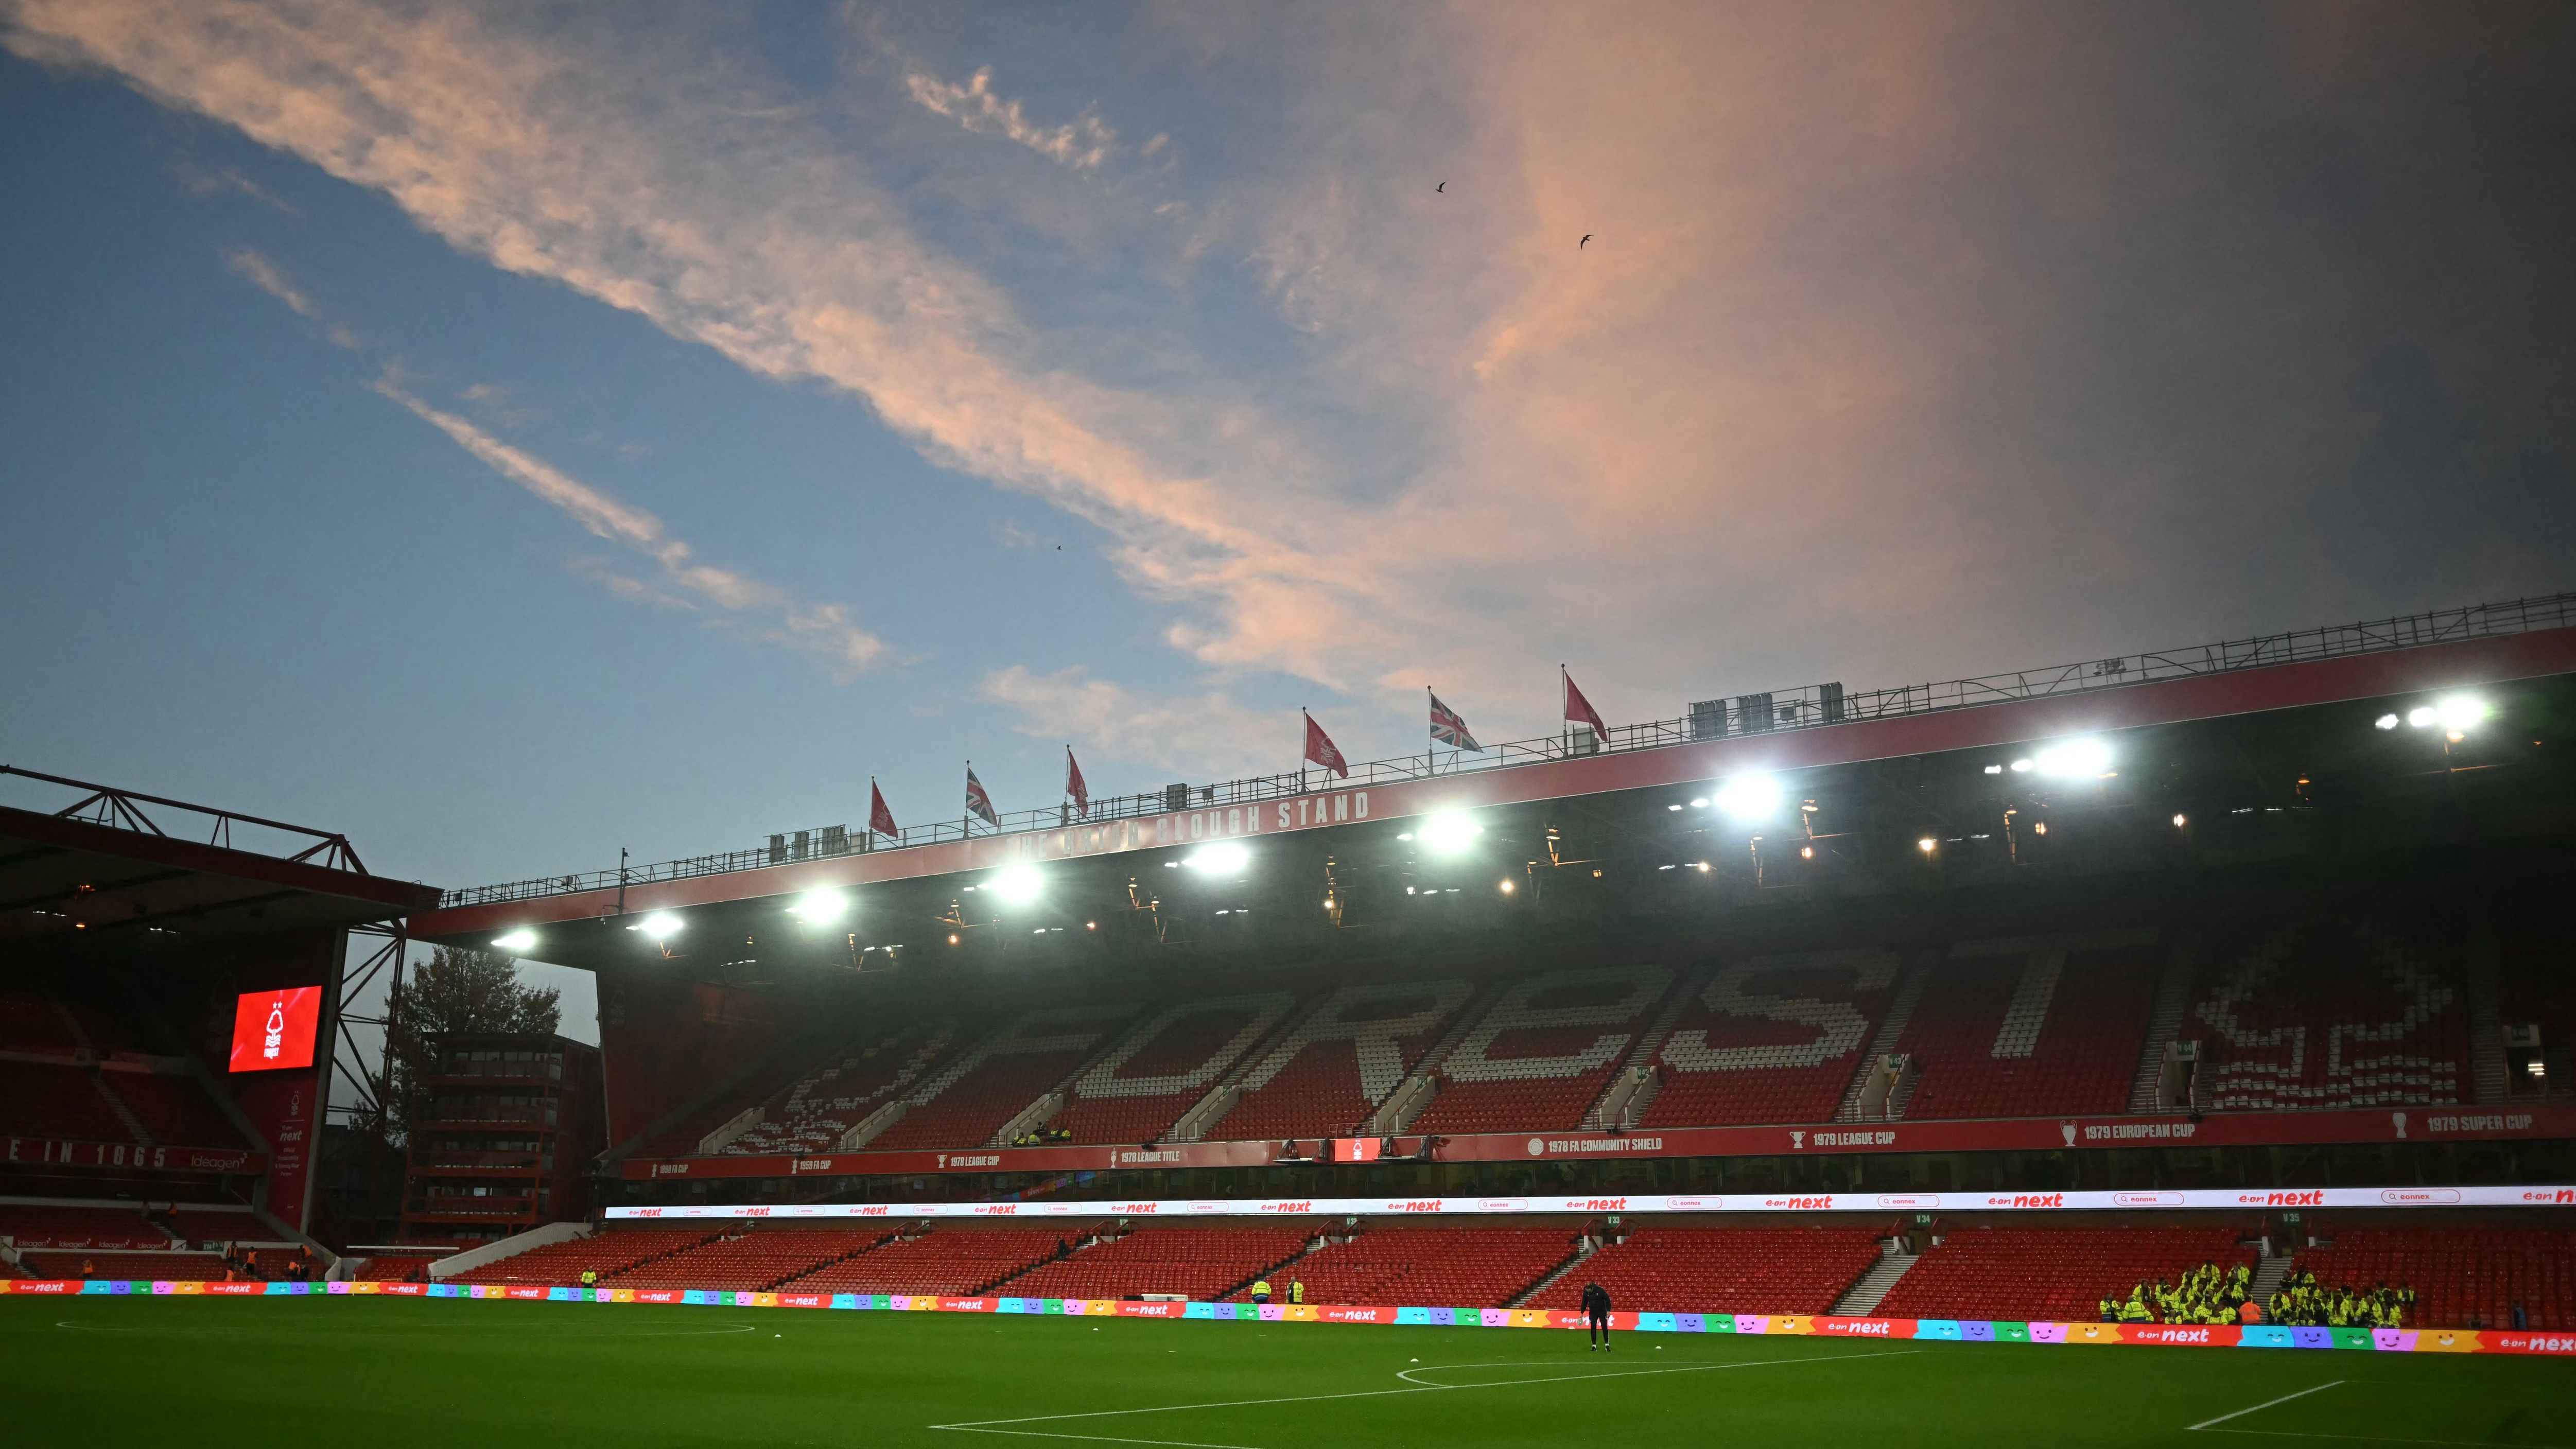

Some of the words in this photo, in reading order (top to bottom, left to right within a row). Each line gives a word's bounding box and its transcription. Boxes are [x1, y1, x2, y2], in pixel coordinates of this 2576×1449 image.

[1064, 822, 1139, 855] BRIAN
[1156, 806, 1259, 842] CLOUGH
[1278, 792, 1368, 828] STAND
[2428, 1117, 2458, 1131] 1979
[2461, 1115, 2504, 1130] SUPER
[2506, 1115, 2532, 1129] CUP
[280, 1130, 302, 1141] next
[2084, 1126, 2111, 1139] 1979
[2112, 1124, 2170, 1139] EUROPEAN
[2172, 1124, 2195, 1138] CUP
[1814, 1133, 1836, 1145] 1979
[1838, 1132, 1874, 1145] LEAGUE
[1876, 1131, 1895, 1144] CUP
[1548, 1141, 1568, 1153] 1978
[1570, 1140, 1579, 1152] FA
[1581, 1139, 1630, 1152] COMMUNITY
[1632, 1138, 1662, 1150] SHIELD
[9, 1139, 21, 1160] E
[44, 1141, 73, 1162] IN
[97, 1144, 165, 1166] 1865
[1121, 1152, 1136, 1162] 1978
[1137, 1151, 1161, 1162] LEAGUE
[1162, 1150, 1179, 1161] TITLE
[191, 1154, 239, 1171] Ideagen
[800, 1161, 812, 1169] 1959
[813, 1161, 820, 1169] FA
[821, 1160, 831, 1169] CUP
[951, 1157, 964, 1166] 1978
[965, 1156, 986, 1166] LEAGUE
[988, 1156, 999, 1165] CUP
[672, 1165, 678, 1173] FA
[678, 1164, 688, 1173] CUP
[1587, 1197, 1627, 1210] next
[1788, 1195, 1833, 1209] next
[2013, 1193, 2063, 1208] next
[2267, 1190, 2323, 1206] next
[862, 1205, 888, 1215] next
[988, 1203, 1016, 1214] next
[1126, 1202, 1156, 1213] next
[1278, 1201, 1311, 1212] next
[1406, 1199, 1442, 1211] next
[639, 1208, 662, 1217] next
[746, 1206, 770, 1216] next
[2289, 1214, 2300, 1222] 35
[18, 1239, 46, 1248] Ideagen
[99, 1240, 125, 1249] Ideagen
[137, 1242, 163, 1250] Ideagen
[34, 1282, 64, 1291] next
[225, 1284, 251, 1293] next
[397, 1285, 417, 1293] next
[519, 1289, 538, 1297] next
[650, 1293, 671, 1301] next
[796, 1297, 818, 1305] next
[958, 1299, 982, 1310] next
[1139, 1304, 1168, 1315] next
[1345, 1309, 1376, 1320] next
[1582, 1315, 1614, 1326] nt
[1849, 1321, 1889, 1334] next
[2162, 1329, 2209, 1342] next
[2529, 1338, 2576, 1351] nex
